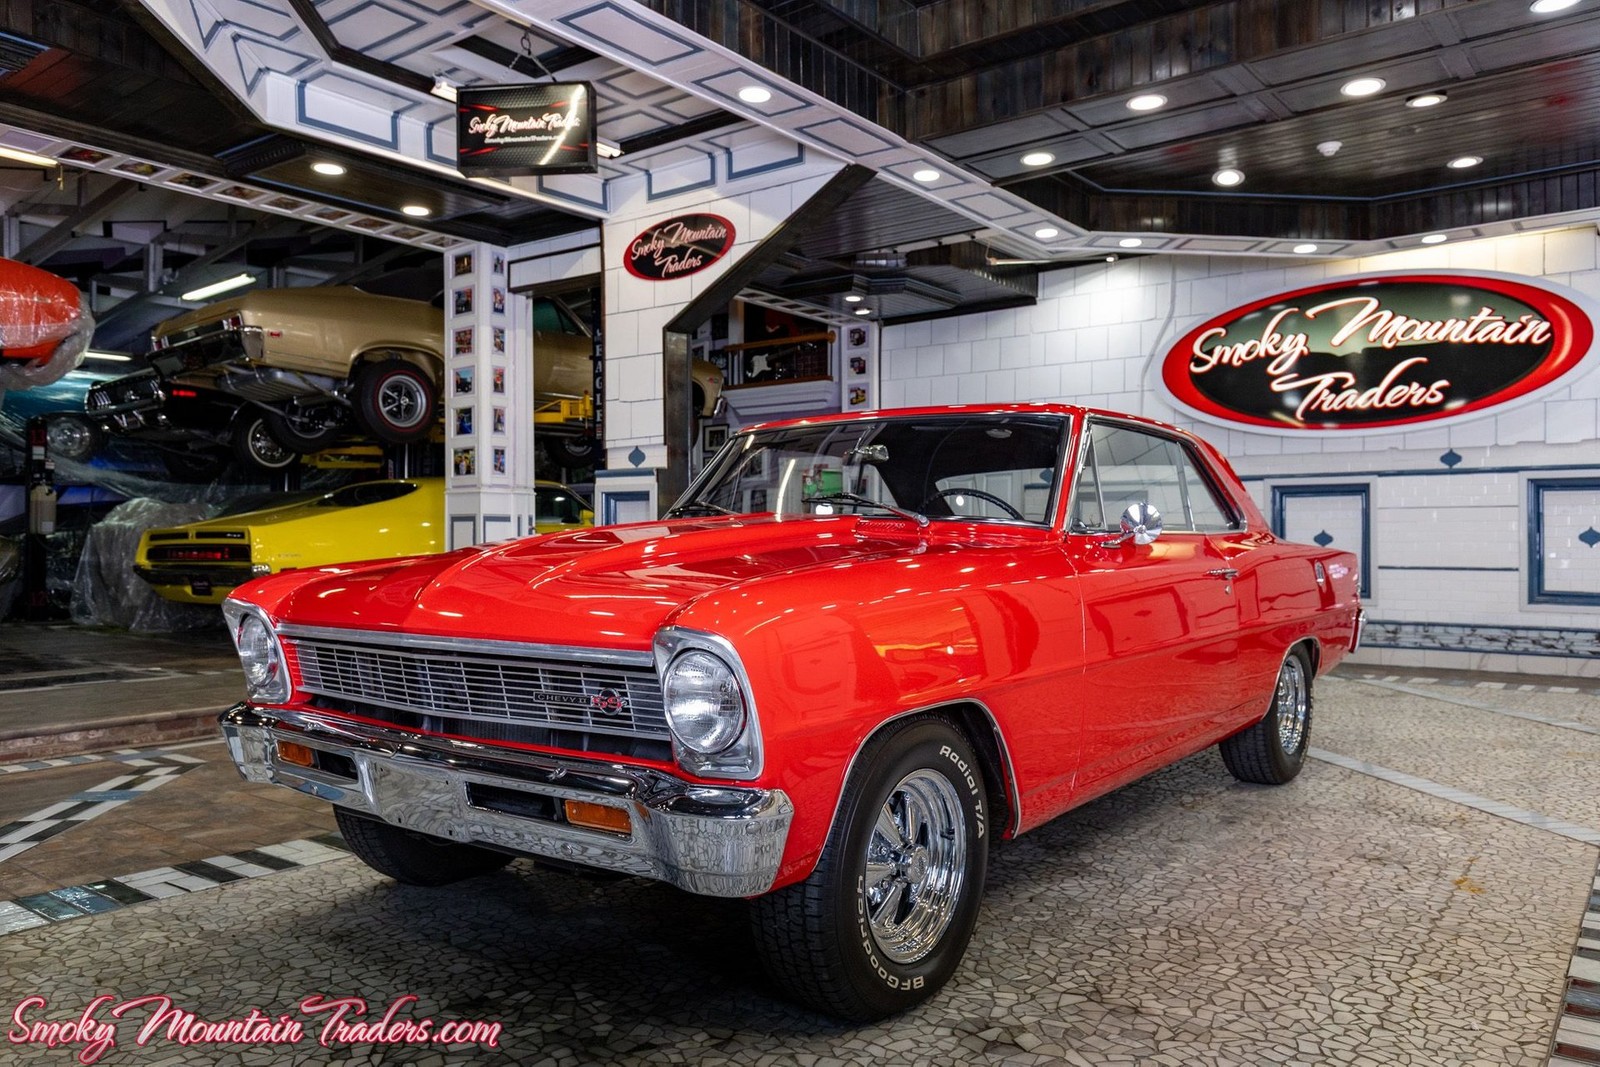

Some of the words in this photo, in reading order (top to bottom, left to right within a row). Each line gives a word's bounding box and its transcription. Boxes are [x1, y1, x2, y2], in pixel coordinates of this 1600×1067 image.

[468, 114, 499, 138] Smoky
[493, 114, 547, 133] Mountain
[631, 228, 666, 260] Smoky
[663, 222, 727, 244] Mountain
[654, 246, 703, 278] Traders
[1190, 307, 1309, 375] Smoky
[1306, 296, 1552, 348] Mountain
[1270, 357, 1450, 421] Traders
[537, 694, 576, 703] CHEVY
[939, 745, 979, 795] Radial
[974, 799, 985, 839] T/A
